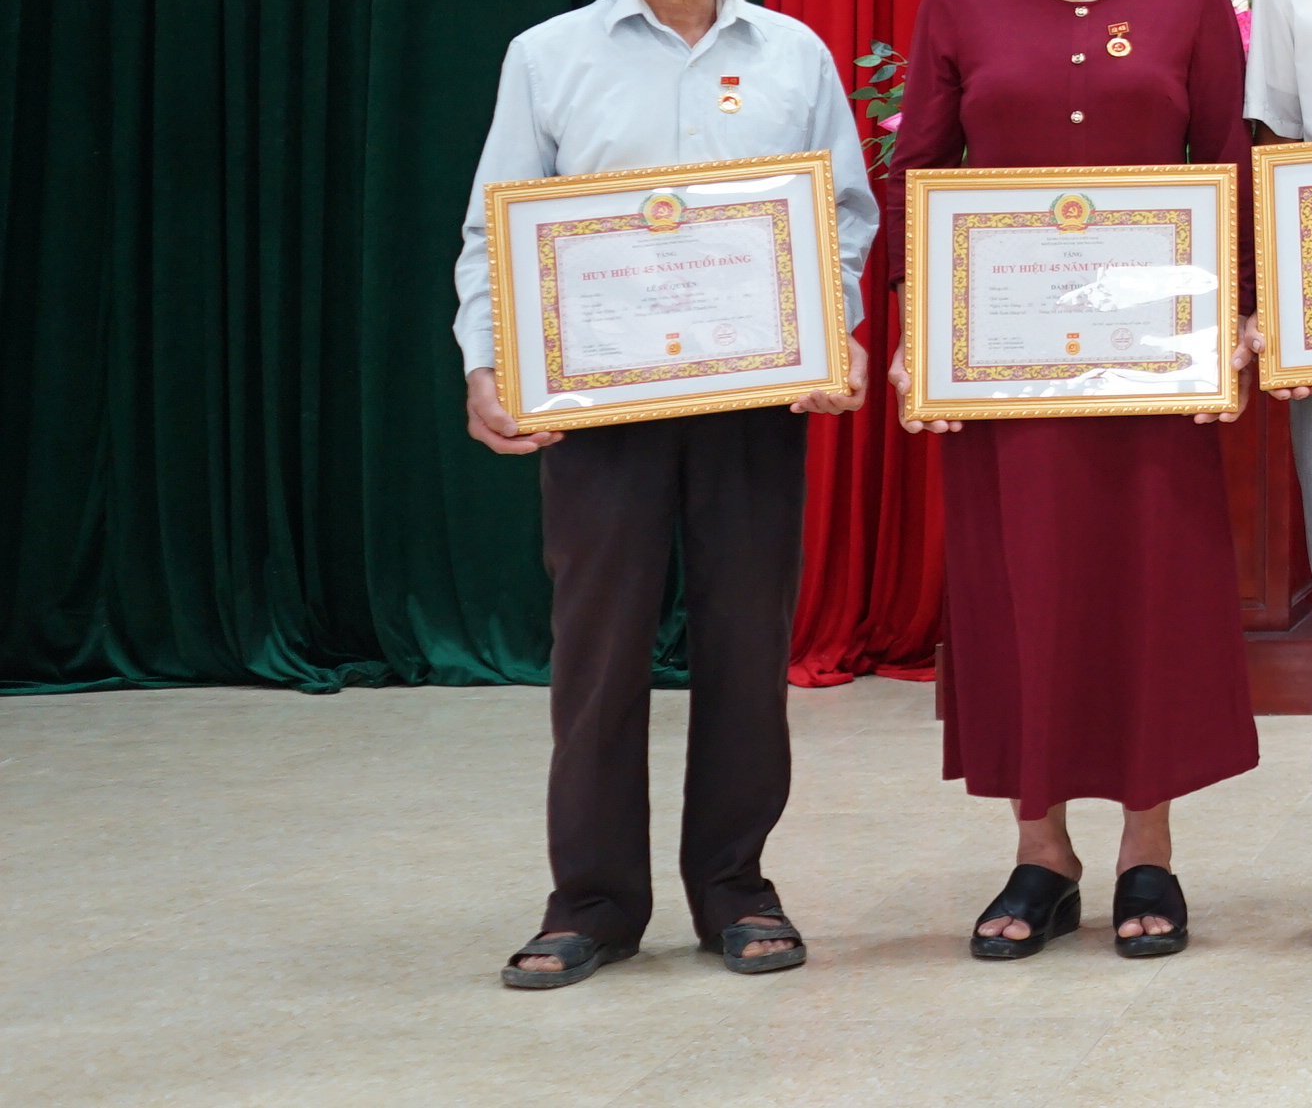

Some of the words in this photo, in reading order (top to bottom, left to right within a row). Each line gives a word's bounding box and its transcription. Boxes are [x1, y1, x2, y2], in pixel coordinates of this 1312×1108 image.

[582, 271, 608, 281] HUY
[610, 266, 640, 279] HIỆU
[656, 261, 684, 273] NĂM
[992, 265, 1017, 274] HUY
[1019, 262, 1047, 275] HIỆU
[1049, 263, 1060, 272] 45
[1062, 261, 1088, 272] NĂM
